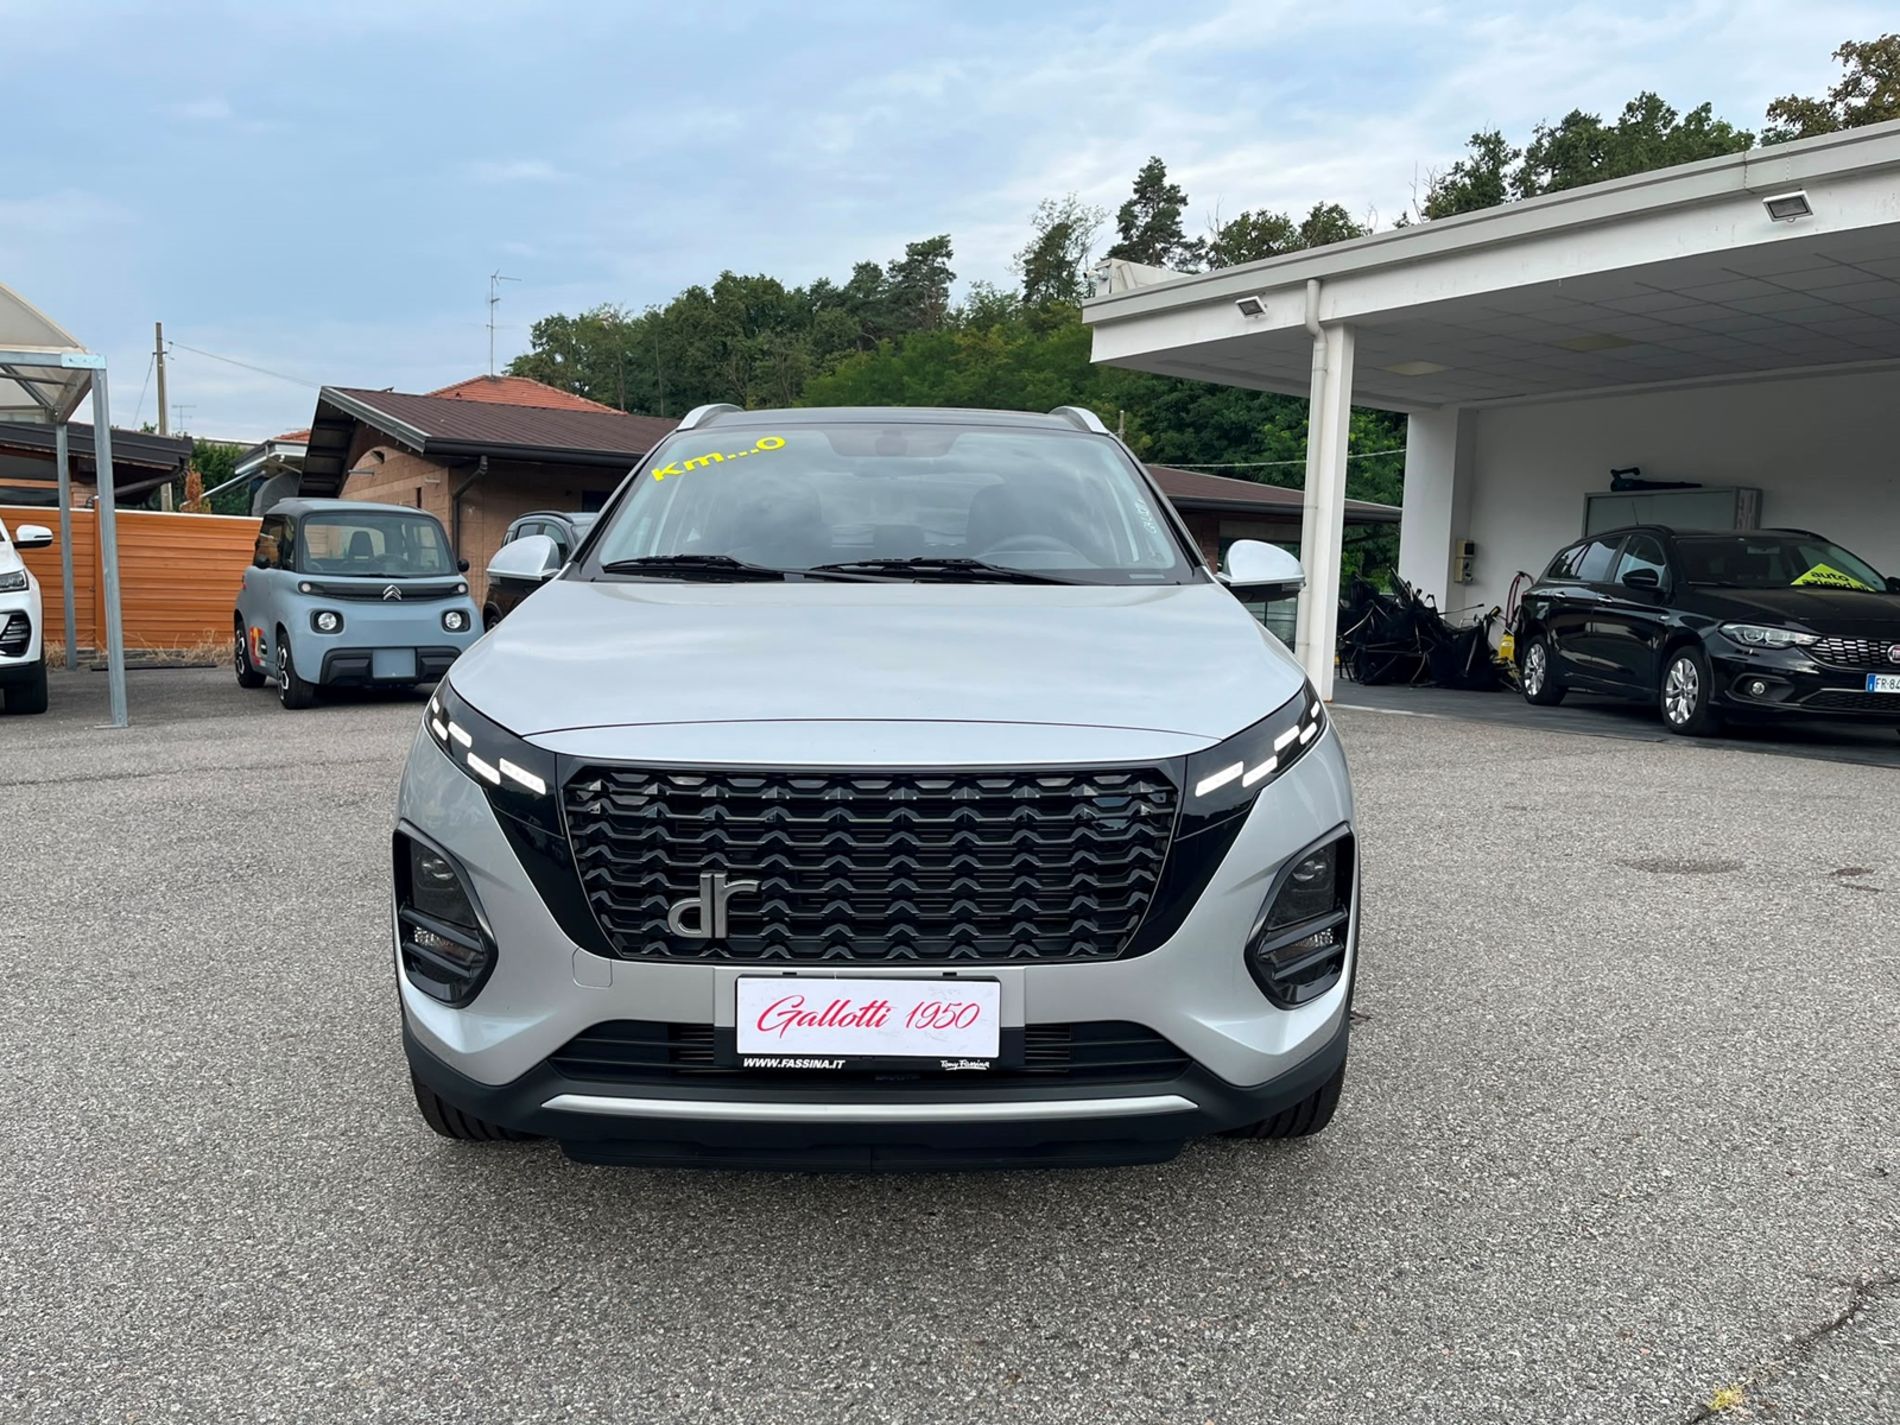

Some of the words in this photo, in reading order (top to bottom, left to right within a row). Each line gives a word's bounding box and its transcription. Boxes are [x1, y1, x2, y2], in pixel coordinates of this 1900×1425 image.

[667, 872, 760, 938] dr
[756, 994, 891, 1039] Gallotti
[904, 1001, 981, 1030] 1950
[743, 1057, 846, 1070] WWW.FASSINA.IT
